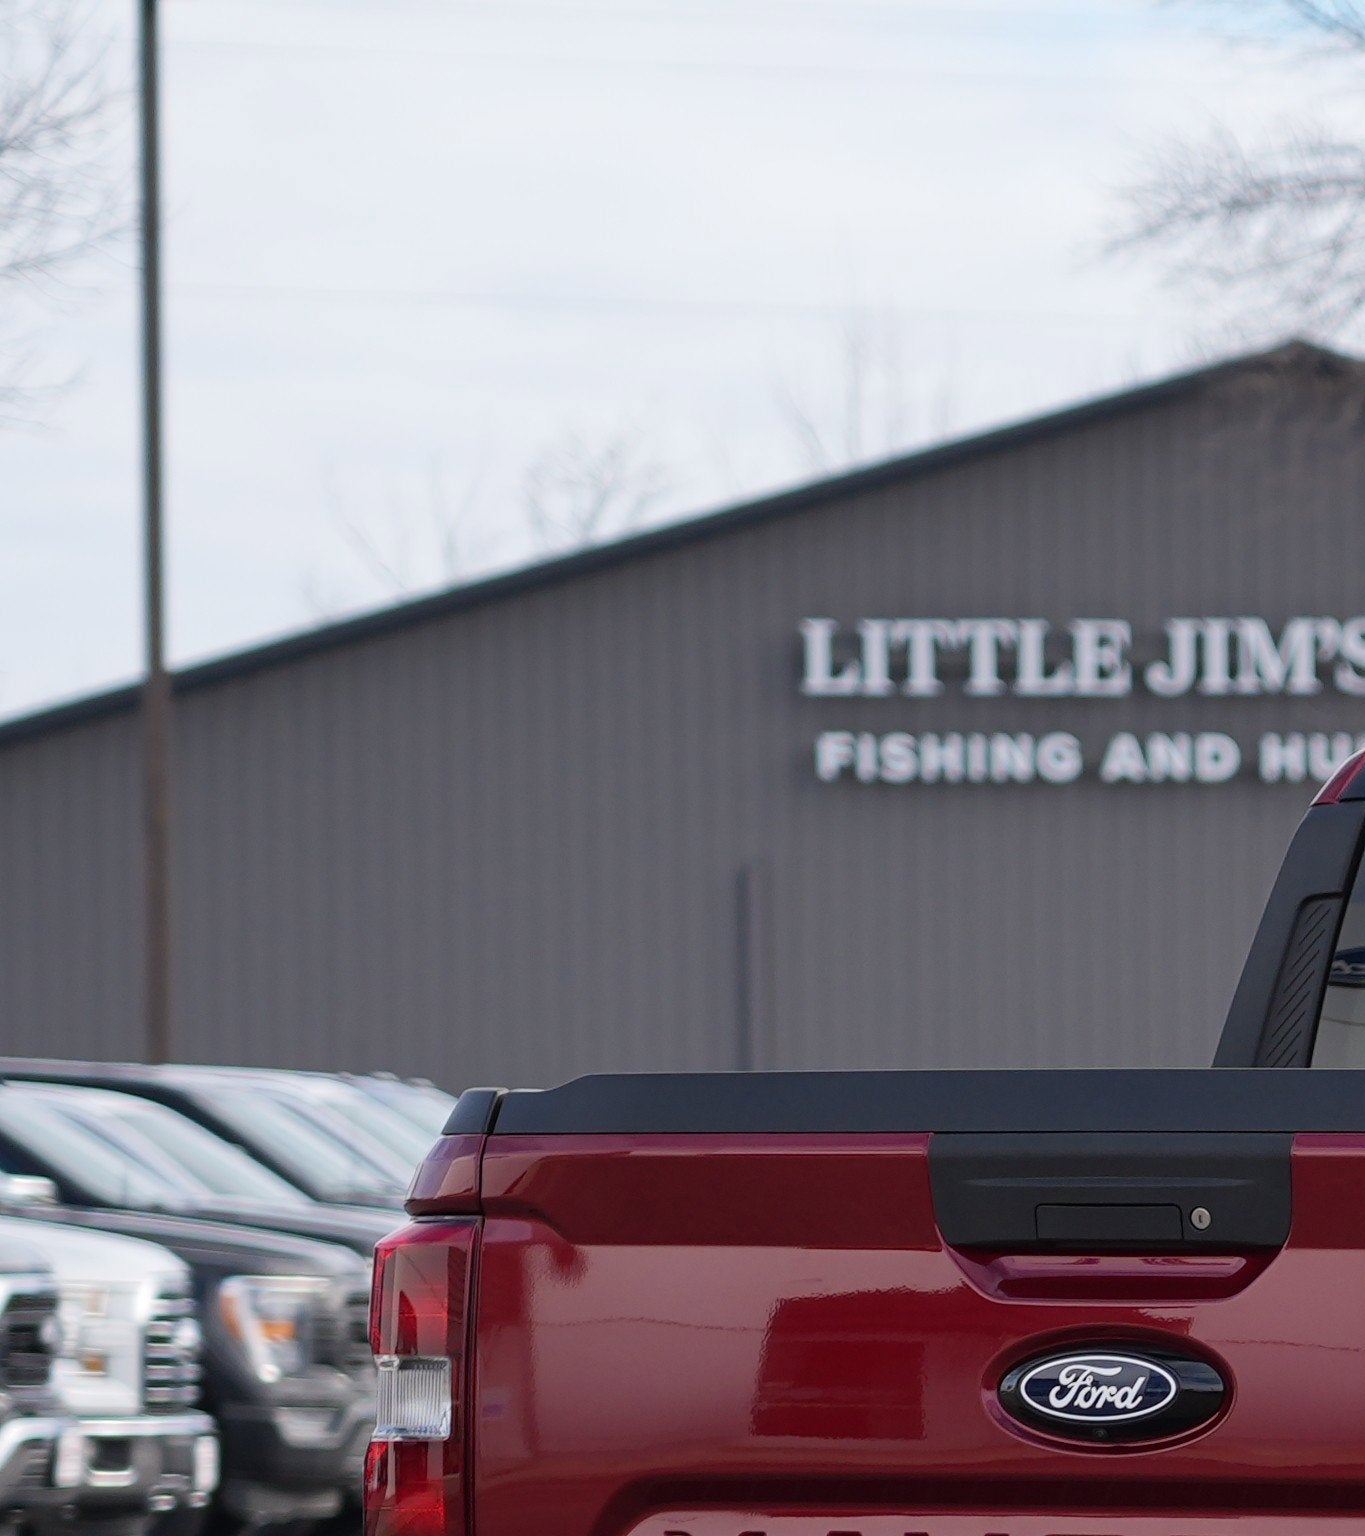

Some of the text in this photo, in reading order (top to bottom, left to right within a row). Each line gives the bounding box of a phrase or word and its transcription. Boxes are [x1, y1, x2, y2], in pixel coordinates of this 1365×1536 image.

[800, 616, 1133, 698] LITTLE
[815, 731, 1084, 785] FISHING
[1101, 731, 1241, 784] AND
[1047, 1363, 1147, 1410] Ford
